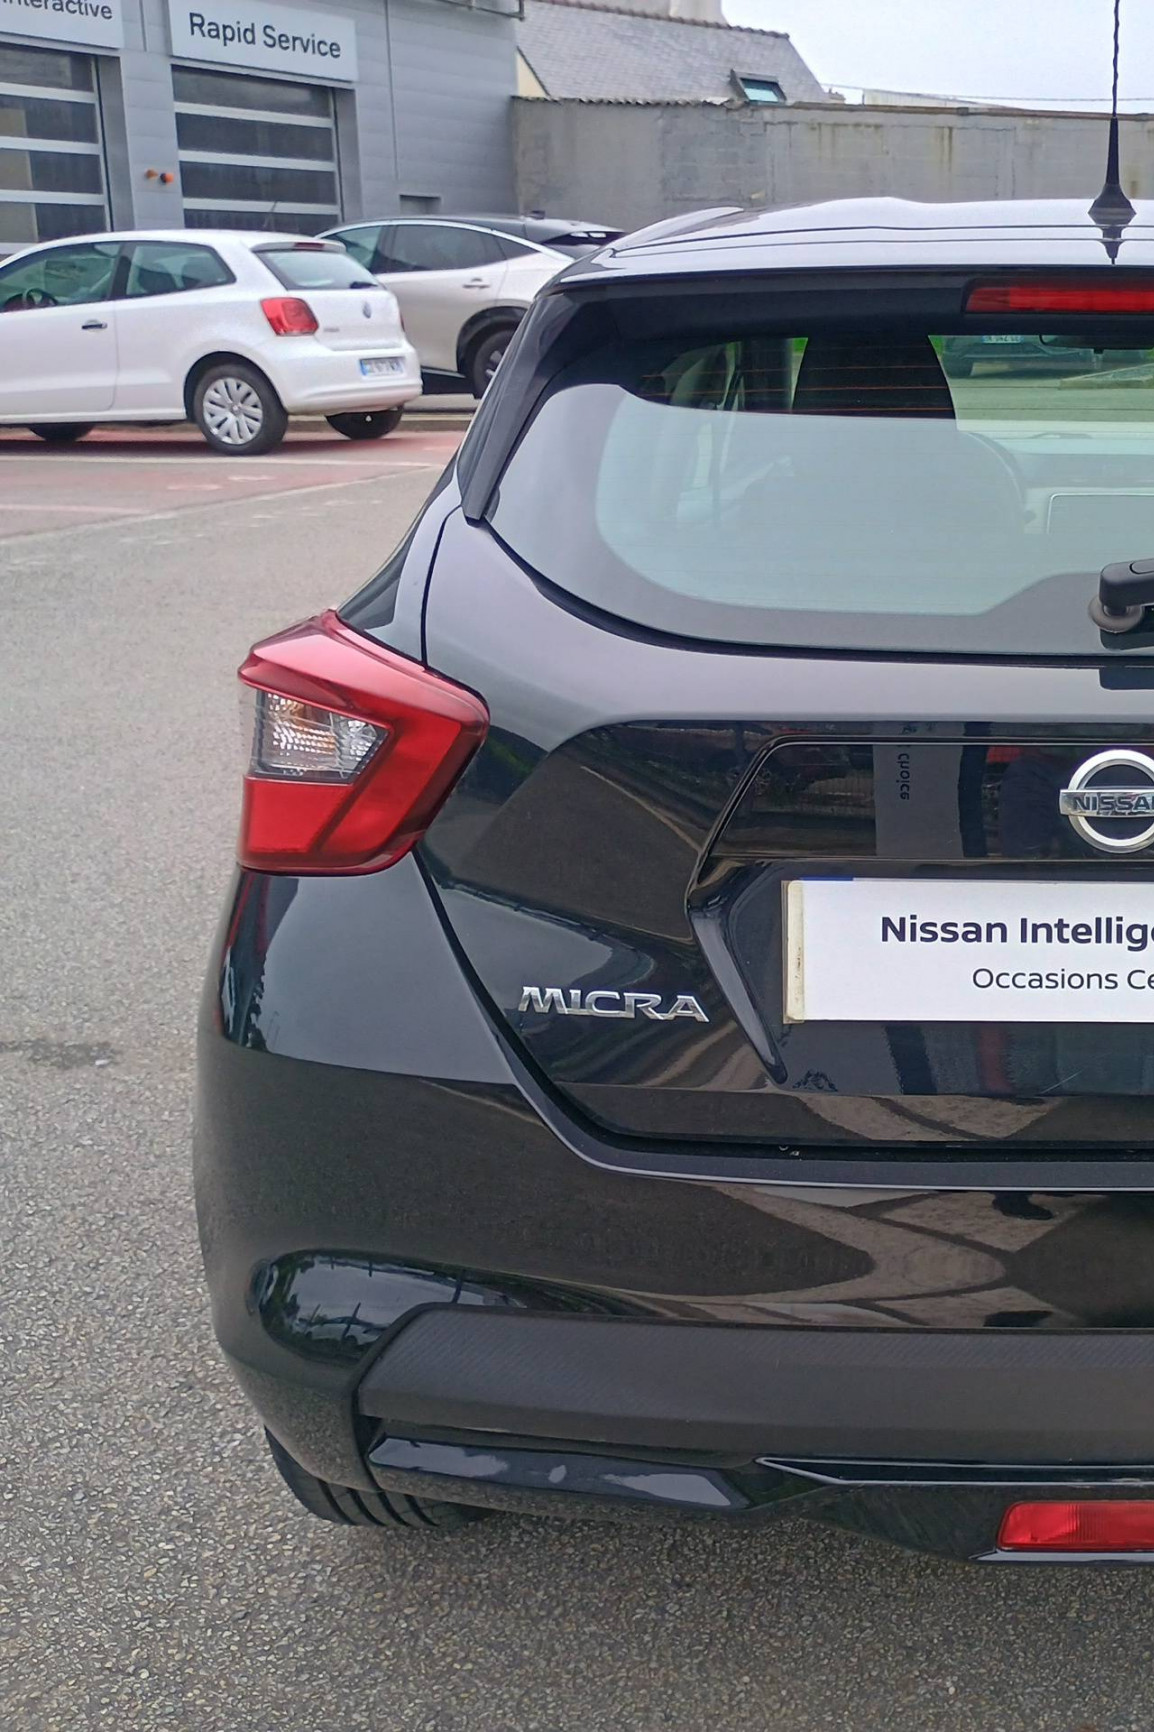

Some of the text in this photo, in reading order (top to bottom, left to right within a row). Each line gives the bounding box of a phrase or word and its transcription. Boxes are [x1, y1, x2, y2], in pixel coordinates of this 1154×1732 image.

[3, 0, 113, 19] eractive
[189, 12, 341, 58] Rapid Service
[881, 915, 1007, 943] Nissan
[972, 968, 1118, 990] Occasions
[518, 986, 710, 1023] MICRA
